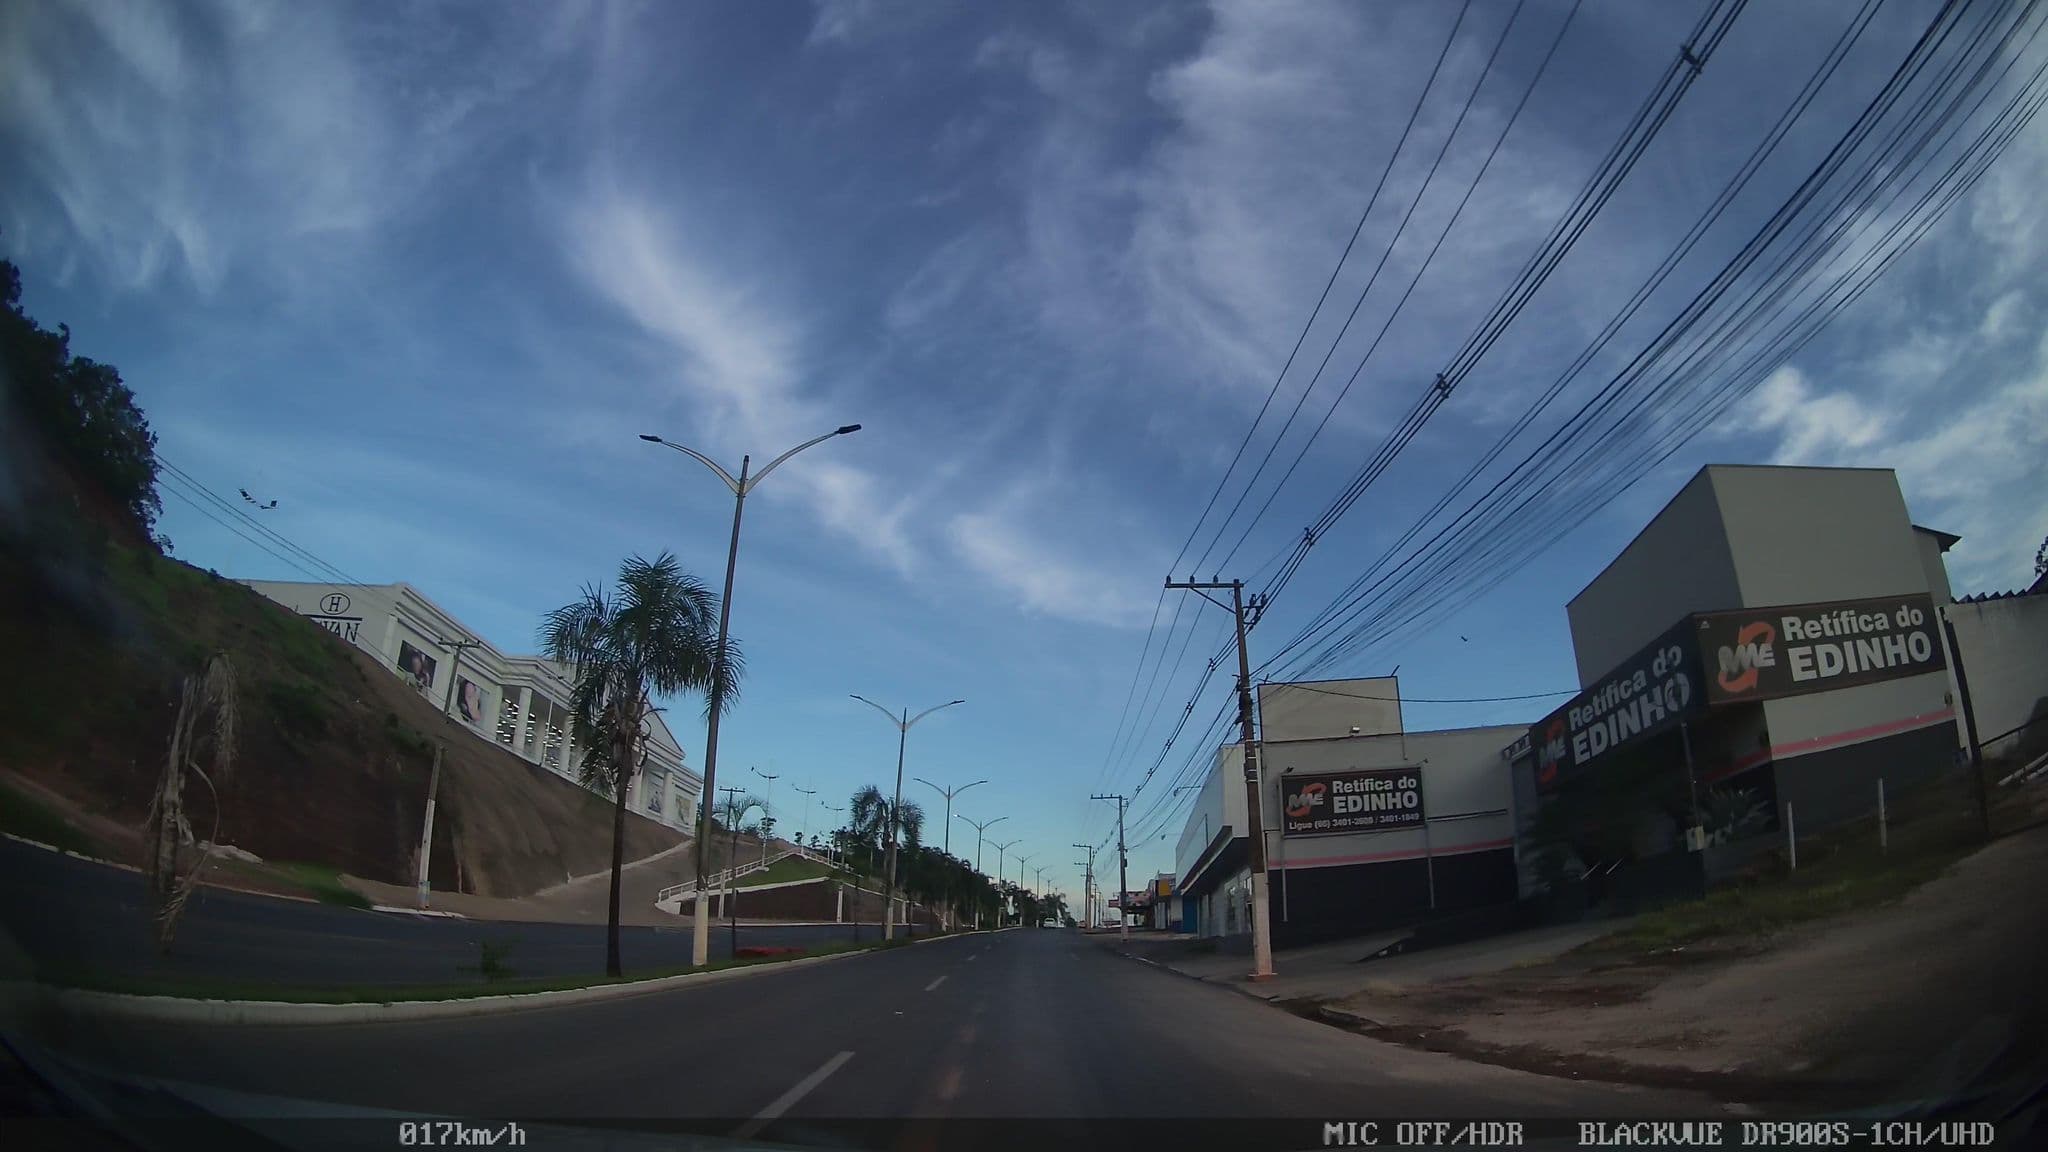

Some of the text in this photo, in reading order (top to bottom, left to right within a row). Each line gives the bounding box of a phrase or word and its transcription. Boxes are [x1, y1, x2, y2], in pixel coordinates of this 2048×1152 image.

[328, 596, 342, 612] H
[321, 620, 361, 643] VAN
[1781, 604, 1924, 642] Retífica do
[1787, 630, 1932, 682] EDINHO
[1568, 645, 1683, 732] Retífica do
[1572, 672, 1690, 766] EDINHO
[1332, 775, 1417, 794] Retífica do
[1333, 790, 1419, 814] EDINHO
[1289, 821, 1313, 831] Ligue
